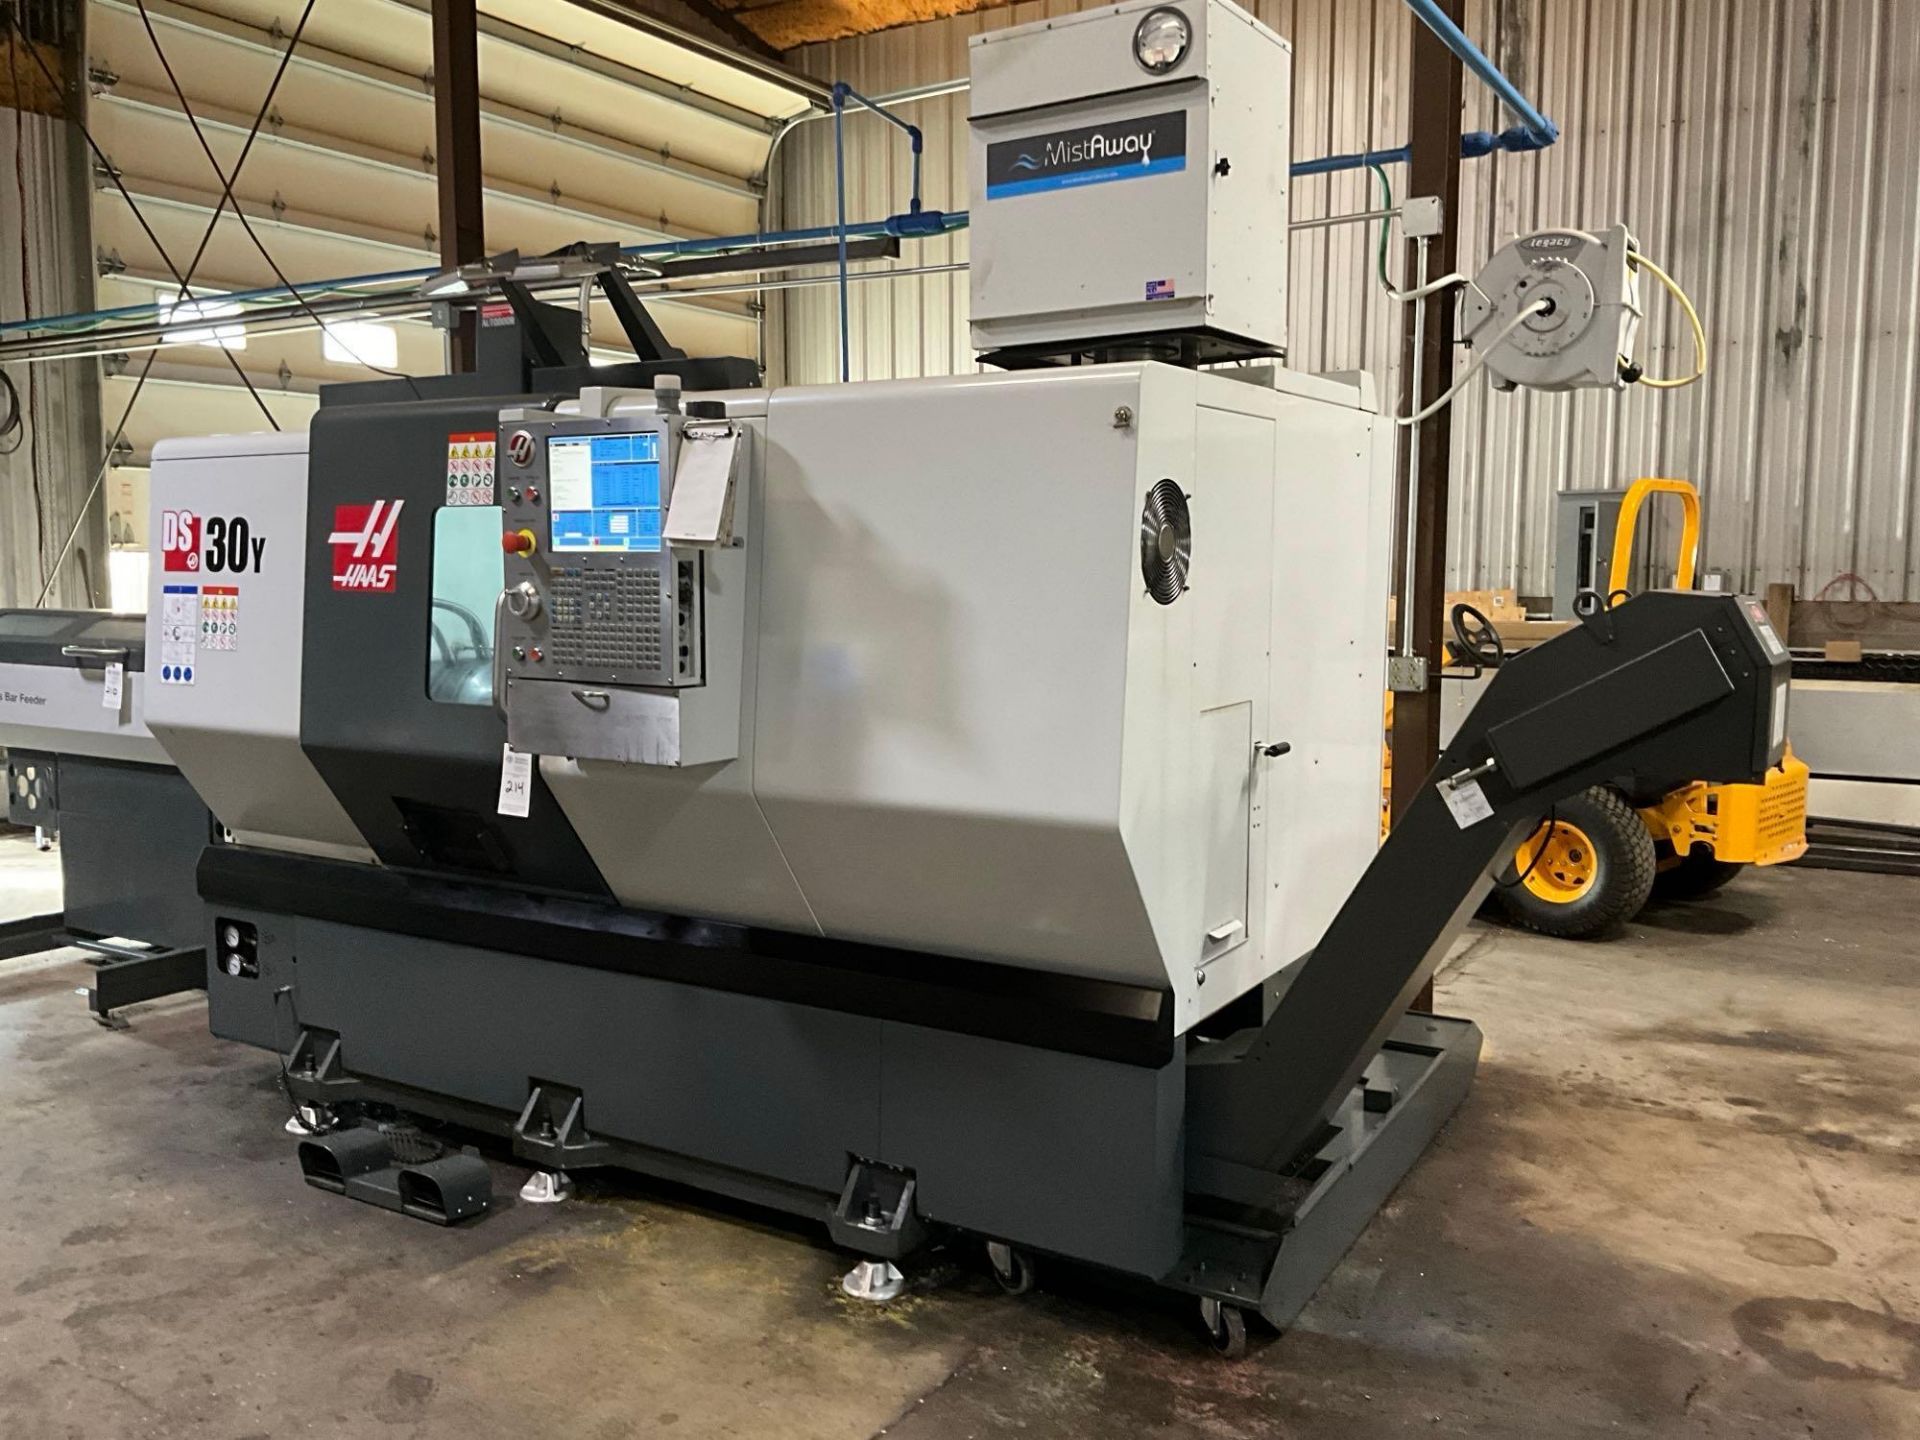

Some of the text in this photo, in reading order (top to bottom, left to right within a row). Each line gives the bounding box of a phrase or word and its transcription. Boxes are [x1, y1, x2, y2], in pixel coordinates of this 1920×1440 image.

[1044, 132, 1153, 167] MistAway
[162, 509, 193, 552] DS
[333, 564, 397, 588] HAAS
[4, 691, 18, 702] Bar
[19, 693, 47, 705] Feeder
[505, 780, 524, 796] 214
